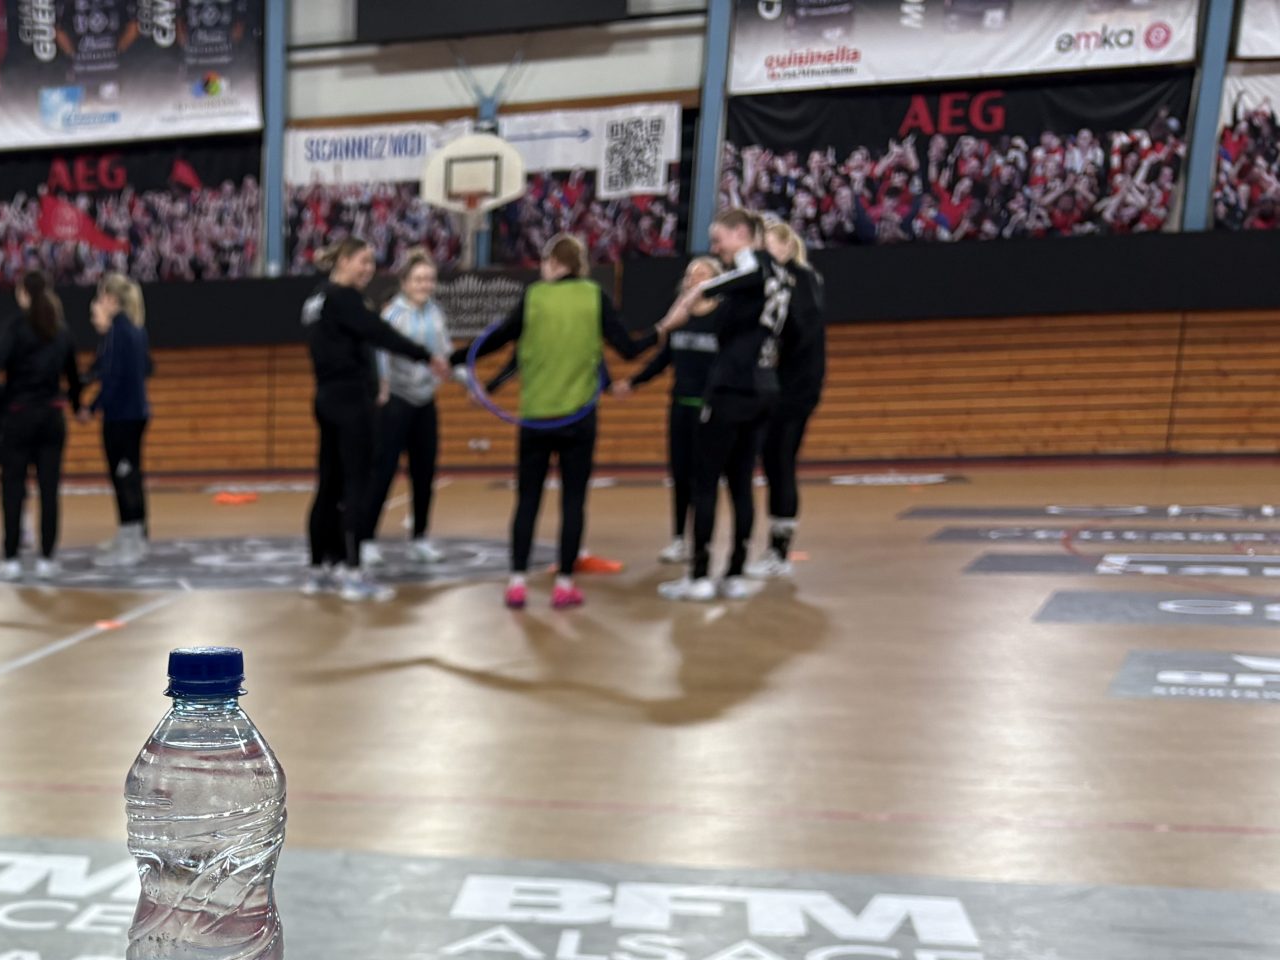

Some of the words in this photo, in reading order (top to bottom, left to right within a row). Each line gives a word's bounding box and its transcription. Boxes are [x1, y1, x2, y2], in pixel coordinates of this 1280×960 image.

[1055, 24, 1134, 53] emka
[899, 90, 1006, 135] AEG
[48, 153, 128, 192] AEG
[449, 874, 981, 946] BFM
